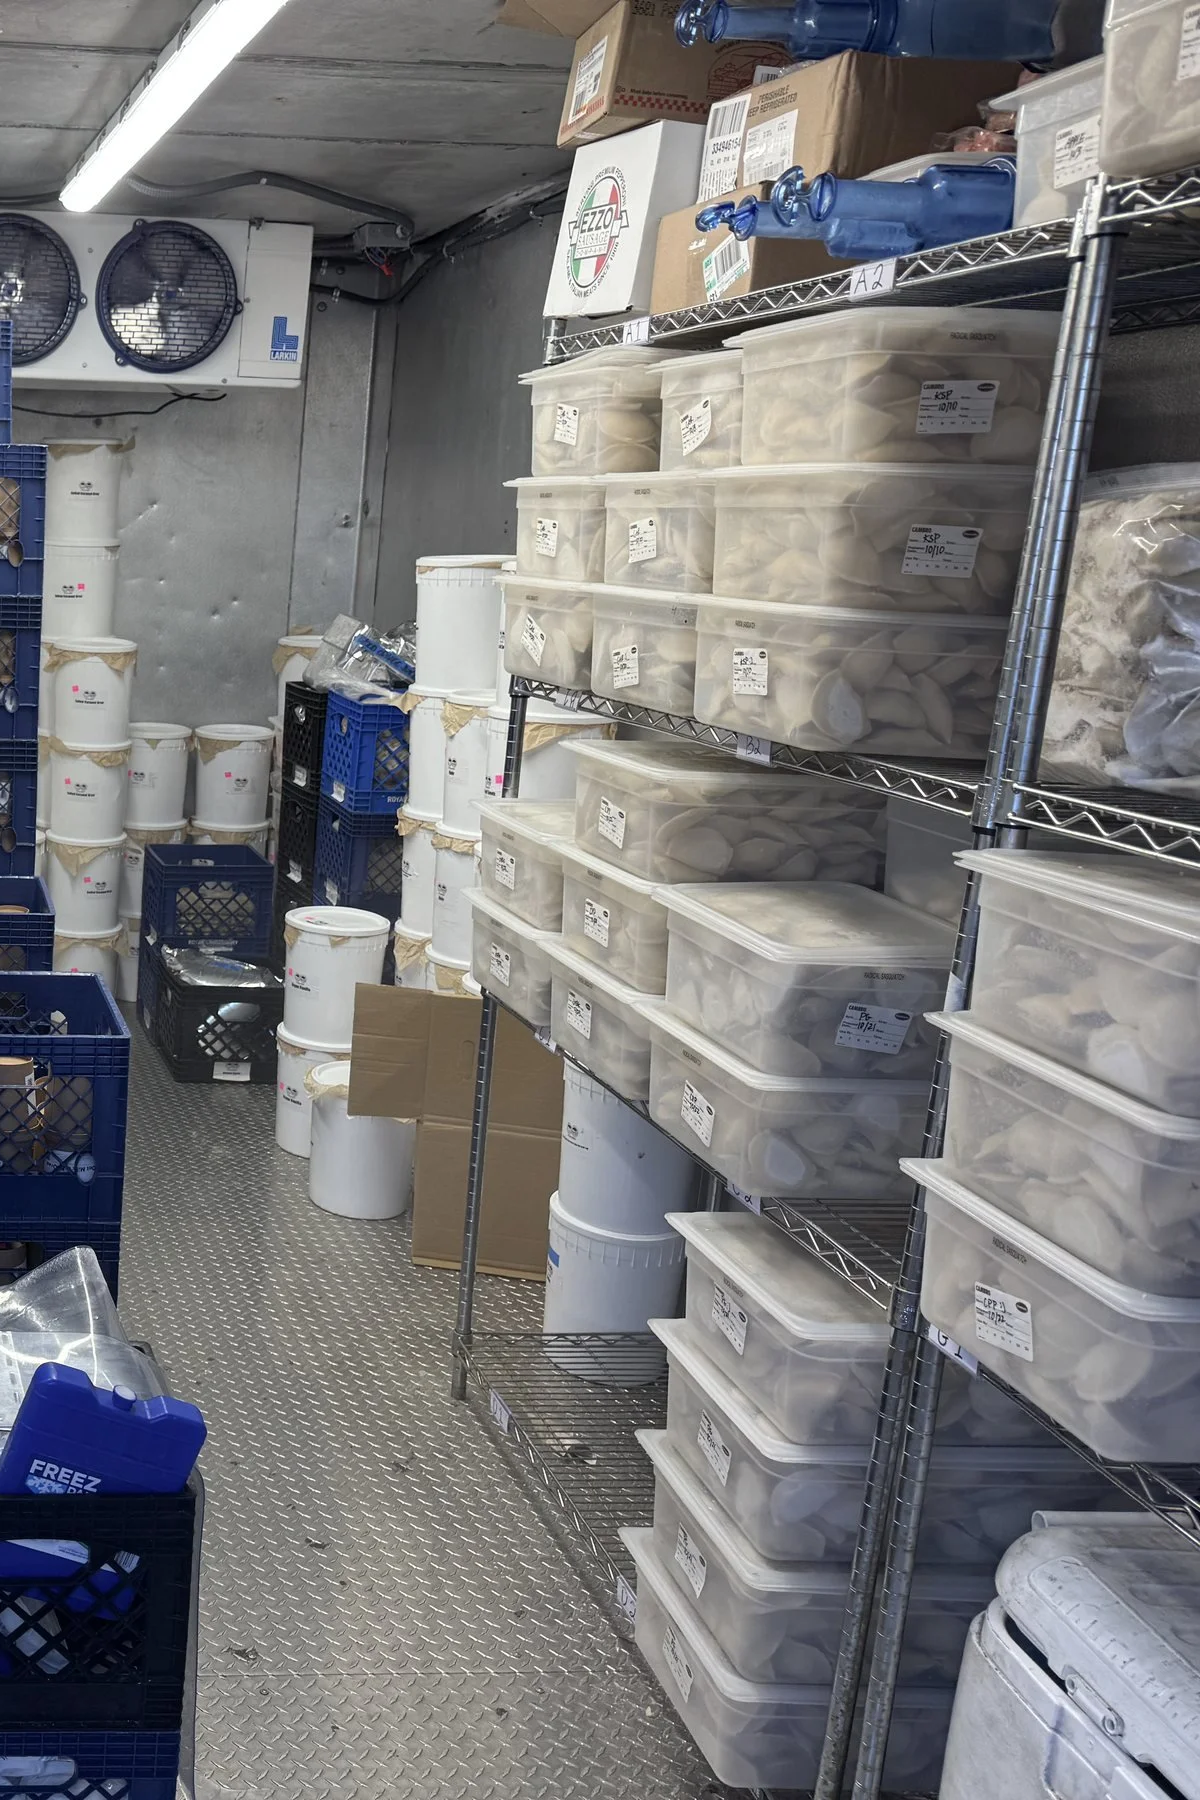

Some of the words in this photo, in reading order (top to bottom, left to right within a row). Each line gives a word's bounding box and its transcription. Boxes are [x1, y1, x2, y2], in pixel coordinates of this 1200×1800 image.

[580, 206, 614, 234] EZZO
[577, 231, 610, 247] SAUSAGE
[853, 263, 884, 295] A2
[625, 321, 642, 344] A1
[271, 351, 297, 361] LARKIN
[934, 390, 953, 400] KSP
[923, 533, 941, 543] KSP
[925, 545, 945, 558] 10/10
[29, 1459, 102, 1493] FREEZ
